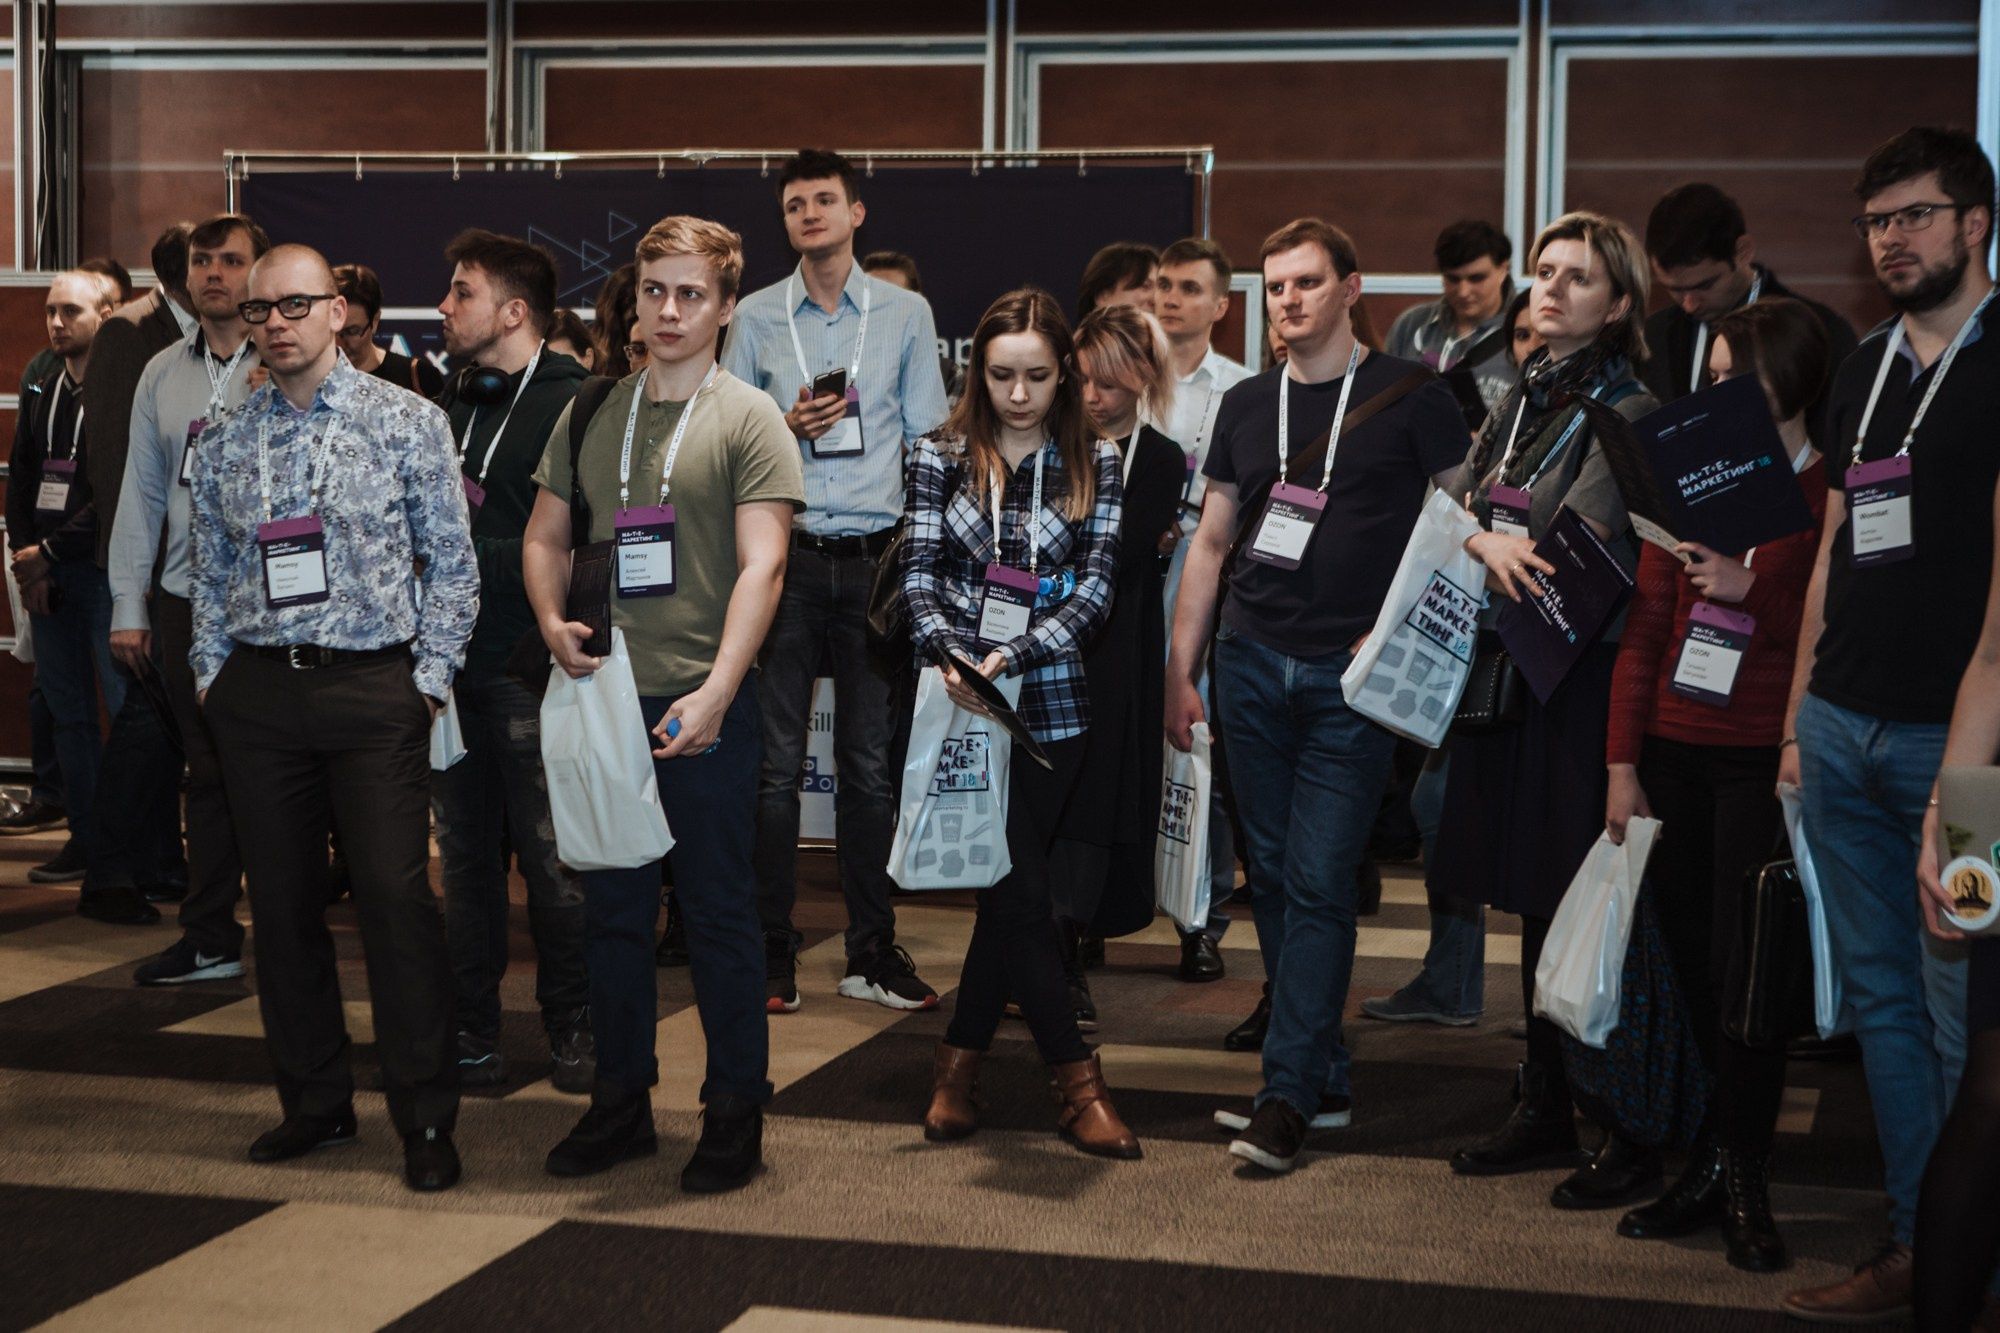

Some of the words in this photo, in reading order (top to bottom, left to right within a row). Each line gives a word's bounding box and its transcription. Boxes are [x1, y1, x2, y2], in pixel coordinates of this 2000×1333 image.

[1681, 460, 1756, 498] МАРКЕТИНГ
[1757, 455, 1773, 468] 18
[1268, 521, 1287, 530] OZON
[988, 607, 1006, 616] OZON
[1423, 596, 1475, 635] МАРКЕ-
[1417, 611, 1454, 644] ТИНГ
[1452, 637, 1468, 654] 18
[1566, 629, 1577, 644] 18
[1689, 647, 1711, 658] OZON
[962, 773, 977, 787] 18
